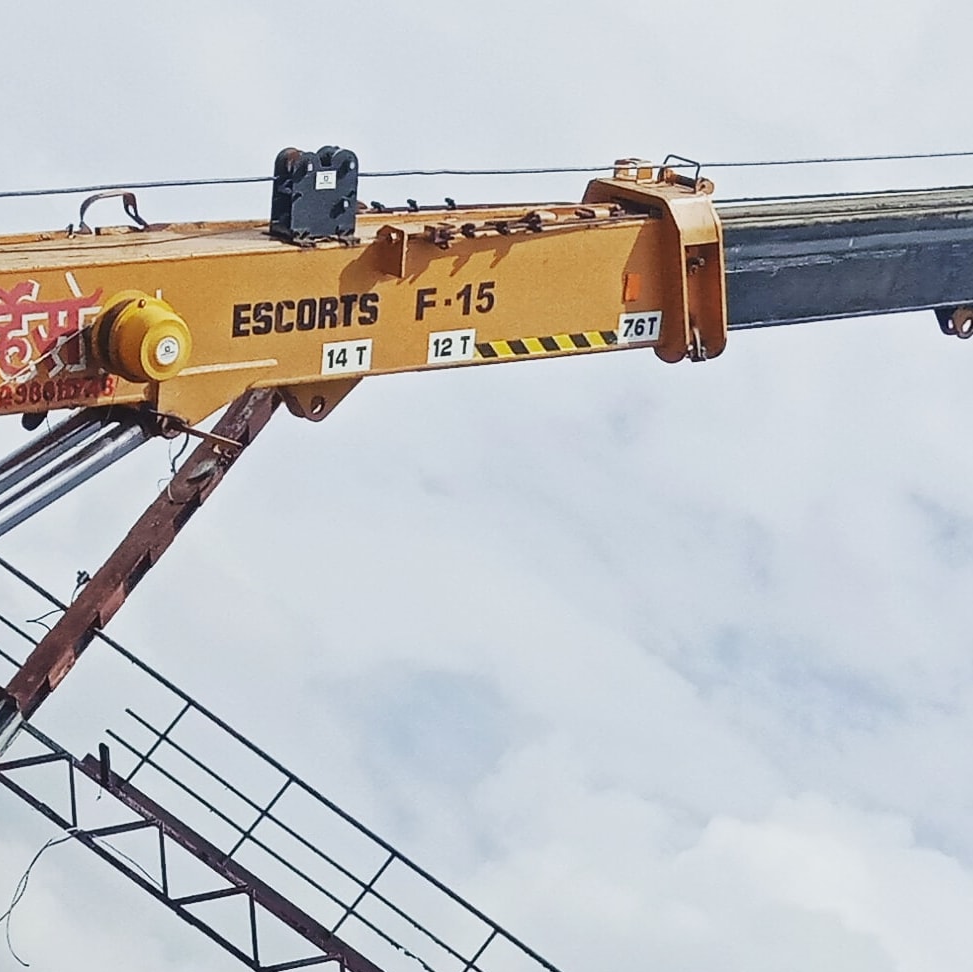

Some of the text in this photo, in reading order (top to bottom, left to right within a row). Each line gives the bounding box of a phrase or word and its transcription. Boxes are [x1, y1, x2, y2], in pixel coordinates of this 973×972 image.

[232, 292, 380, 338] ESCORTS
[327, 345, 367, 369] 14 T
[433, 335, 471, 358] 12 T
